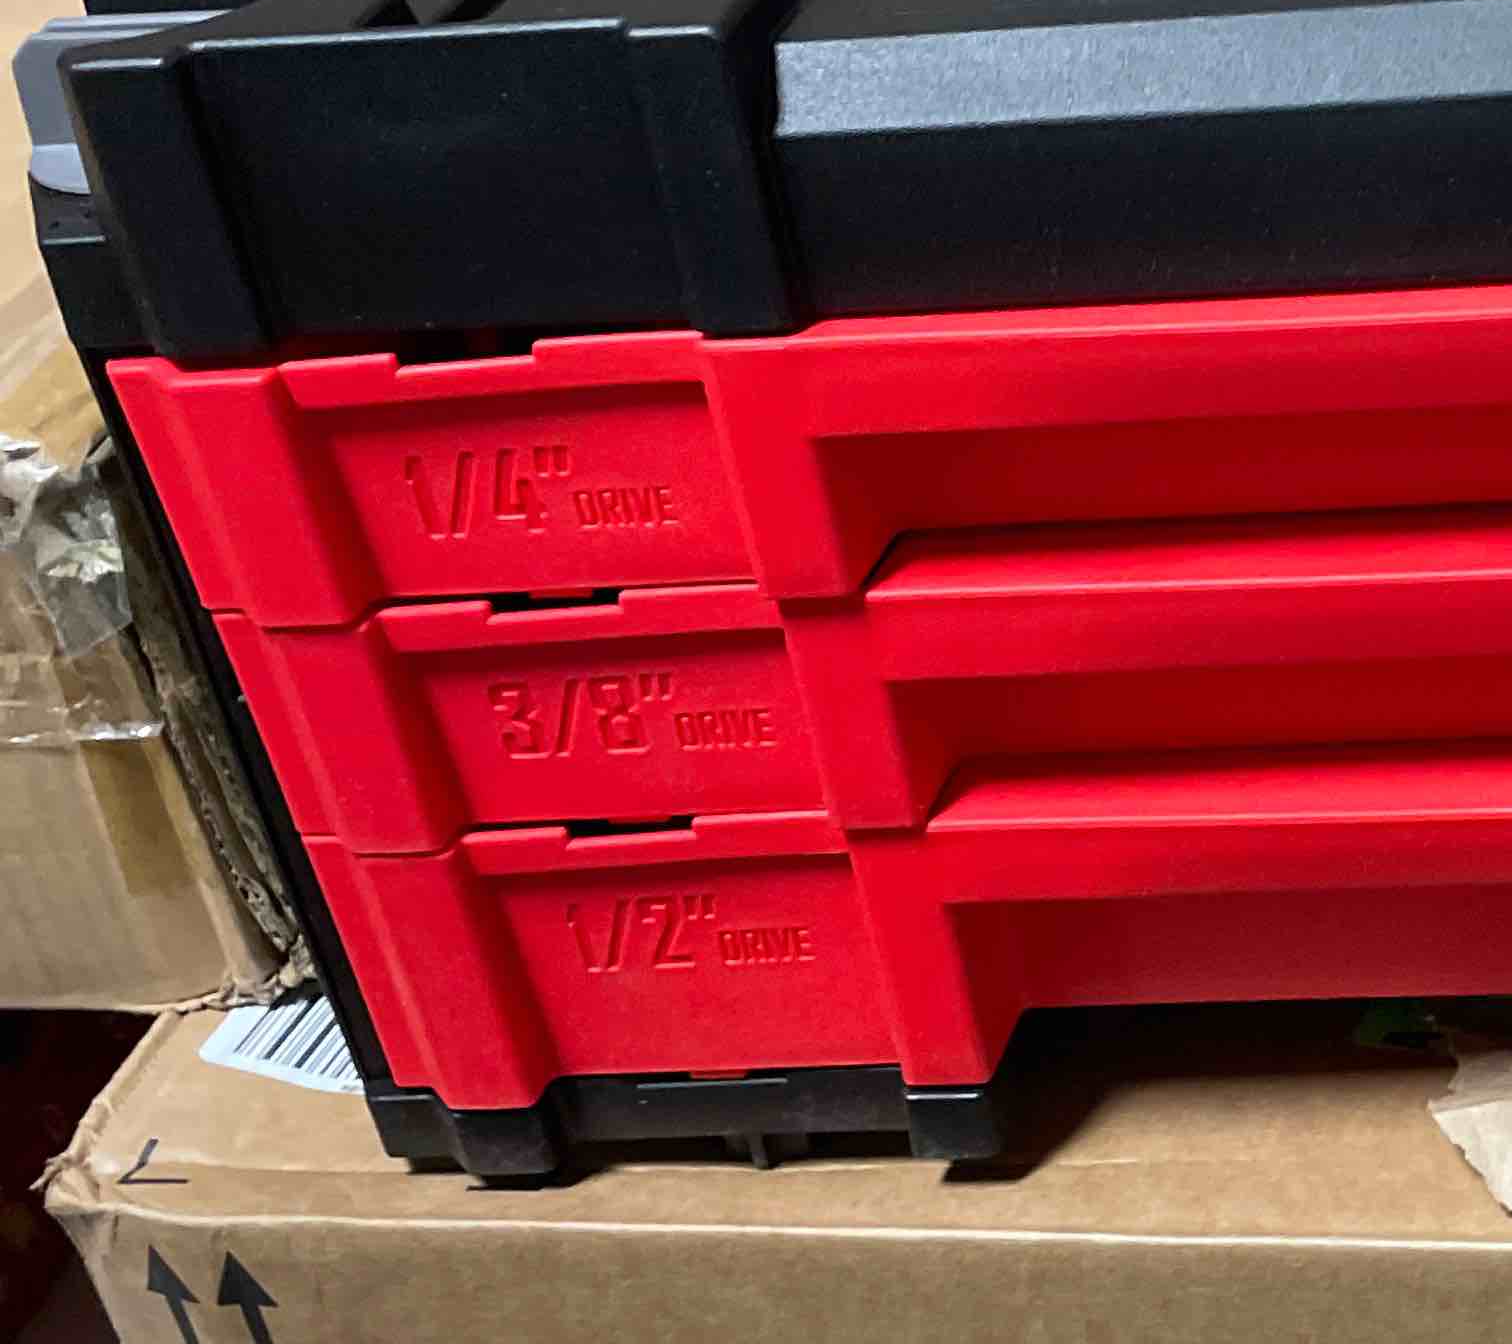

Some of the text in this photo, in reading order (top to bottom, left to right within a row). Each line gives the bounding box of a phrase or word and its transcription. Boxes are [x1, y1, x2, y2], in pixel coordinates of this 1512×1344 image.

[573, 484, 681, 530] DRIVE
[488, 672, 778, 760] 3/8" DRIVE
[565, 892, 816, 974] 1/2" DRIVE
